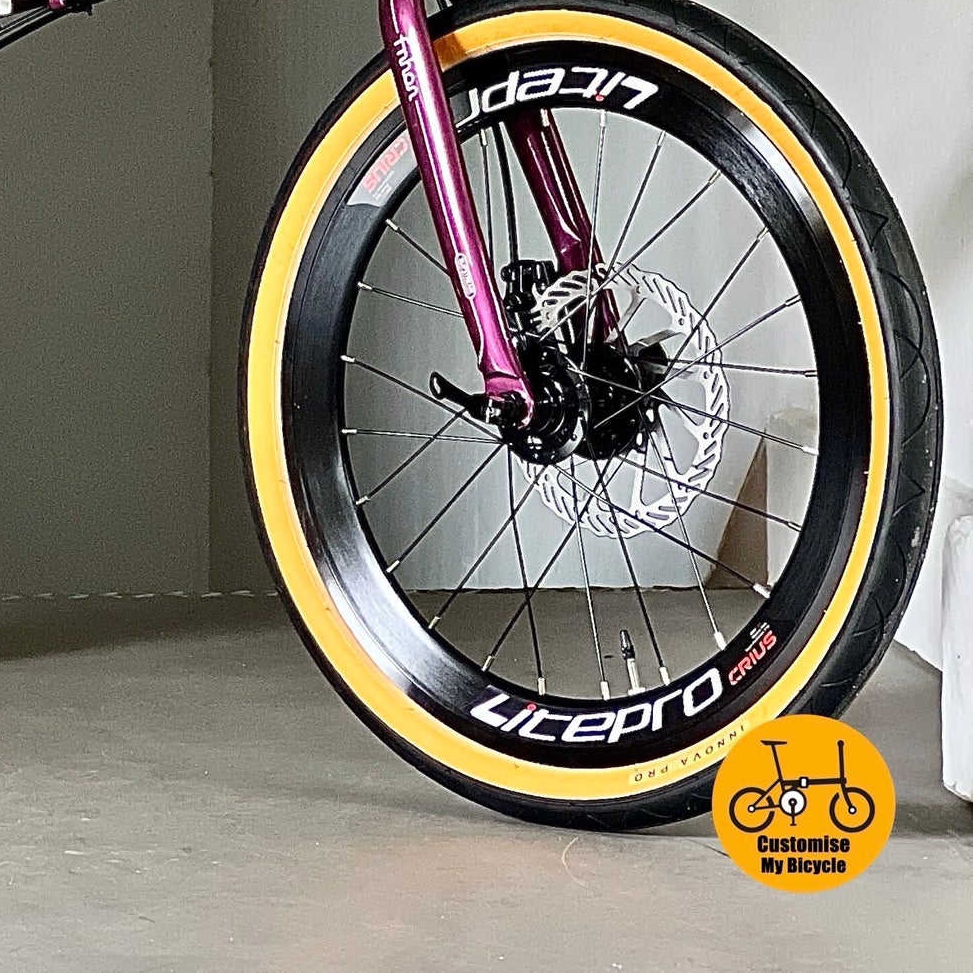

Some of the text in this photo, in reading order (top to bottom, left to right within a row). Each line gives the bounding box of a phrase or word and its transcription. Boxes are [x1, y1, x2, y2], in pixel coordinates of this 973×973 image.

[394, 33, 419, 102] fnhon
[363, 136, 410, 193] CRIUS
[728, 629, 777, 686] CRIUS
[470, 667, 724, 743] Litepro
[634, 724, 745, 782] INNOVA PRO
